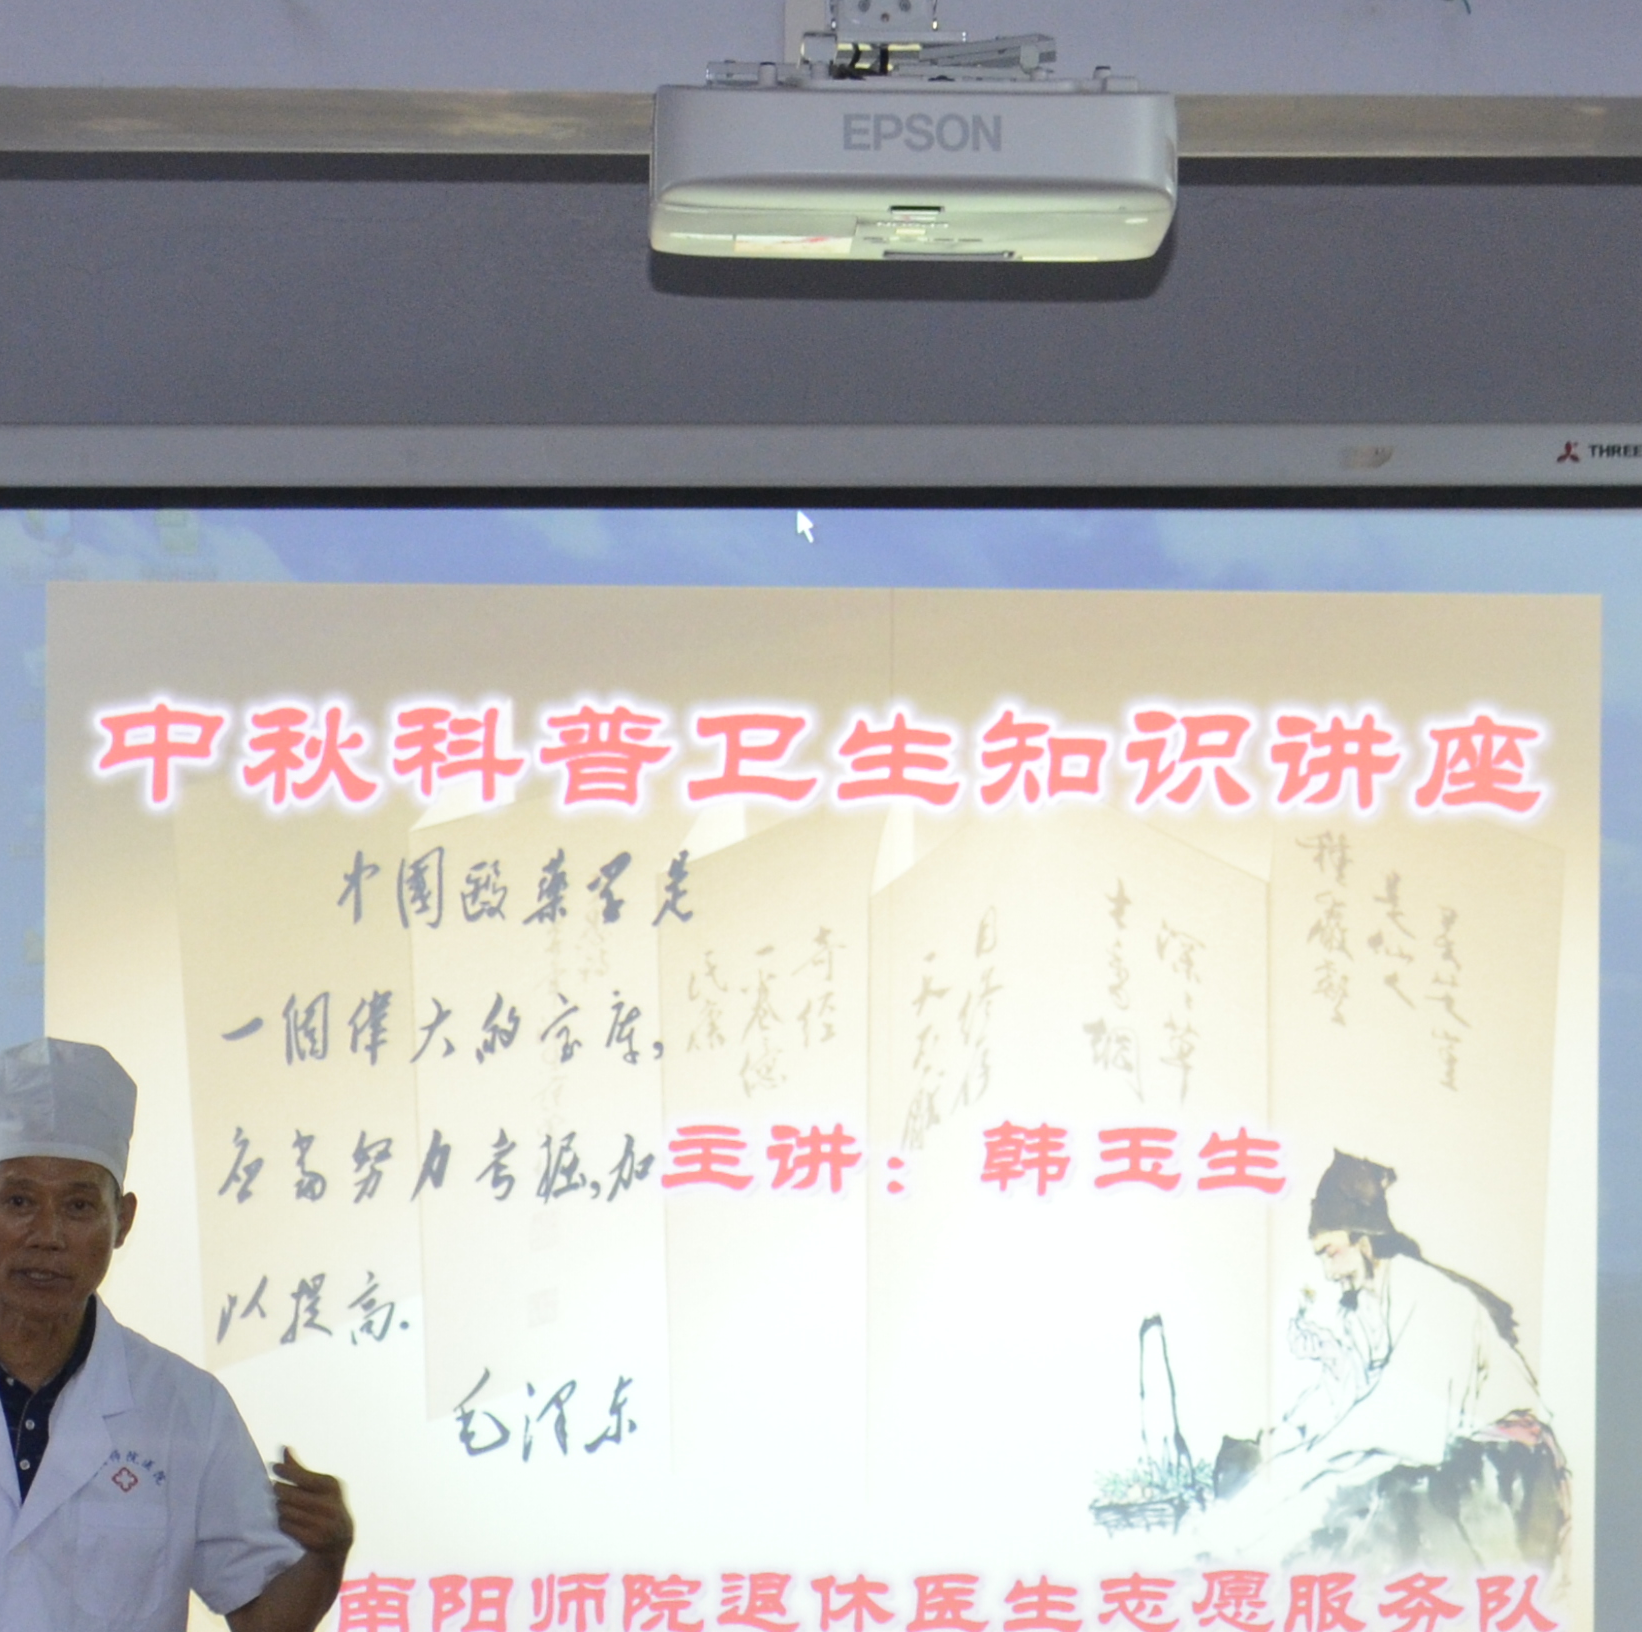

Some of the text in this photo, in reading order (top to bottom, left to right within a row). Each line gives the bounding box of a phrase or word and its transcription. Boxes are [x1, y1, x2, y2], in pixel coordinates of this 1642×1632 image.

[843, 113, 1002, 152] EPSON
[99, 702, 1546, 814] 中秋科普卫生知识讲座
